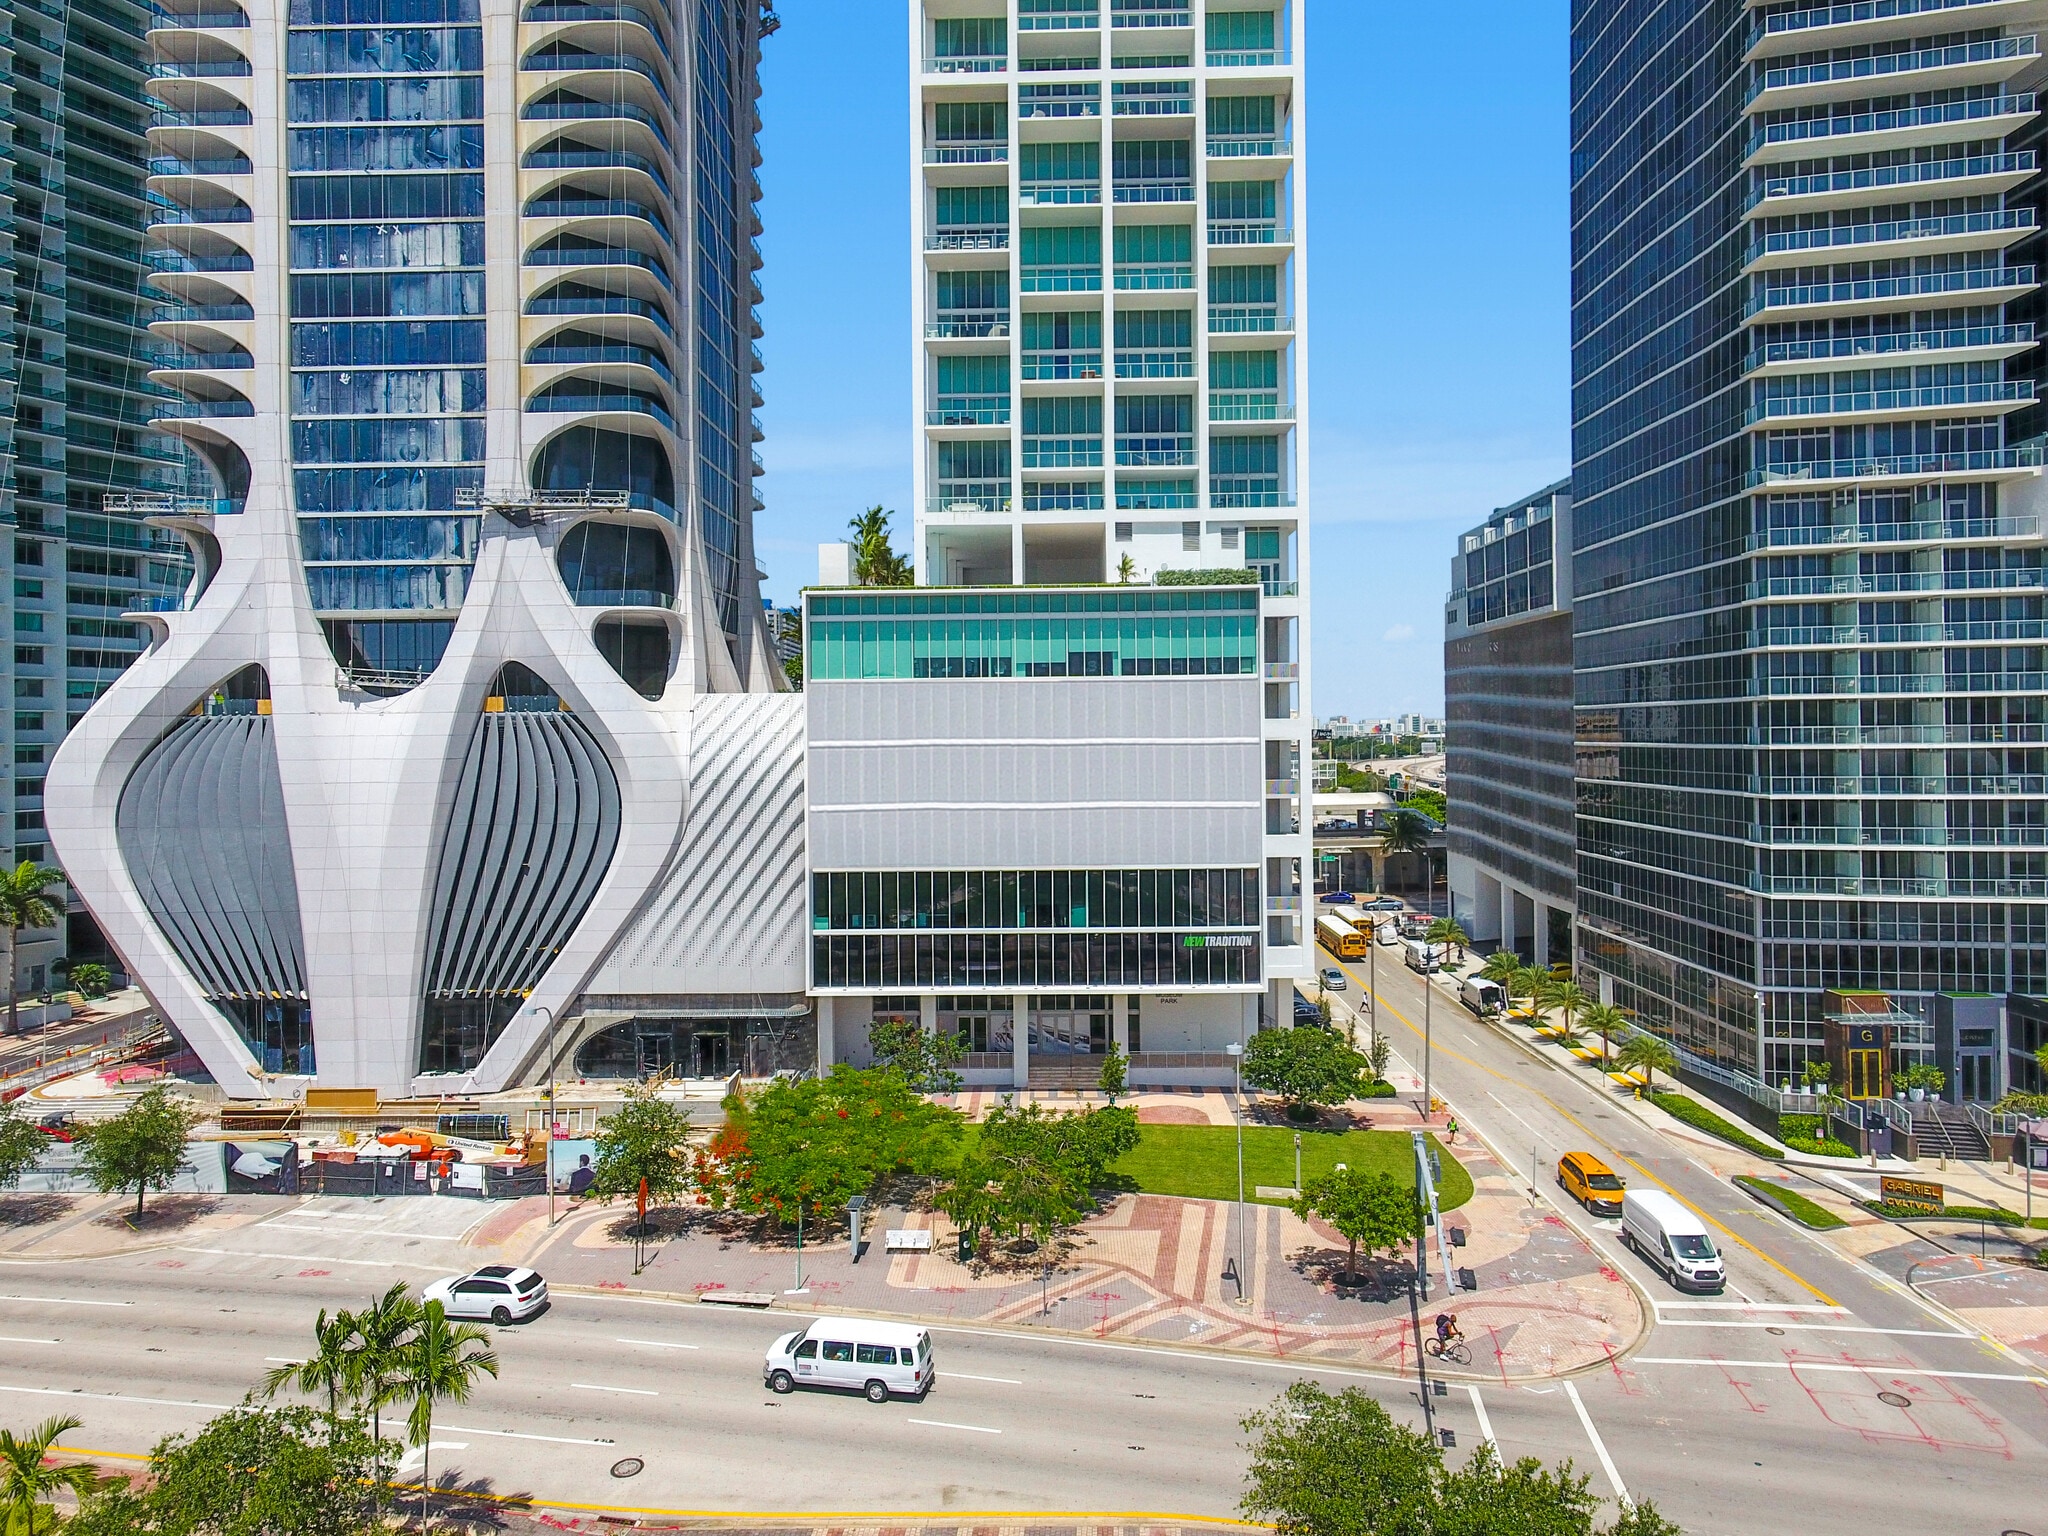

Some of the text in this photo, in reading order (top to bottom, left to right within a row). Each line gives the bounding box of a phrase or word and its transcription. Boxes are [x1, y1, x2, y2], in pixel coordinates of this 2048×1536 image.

[1183, 935, 1252, 947] NEWTRADITION
[1861, 1030, 1873, 1042] G
[454, 1140, 492, 1151] United Rentals
[1886, 1180, 1940, 1197] GABRIEL
[1886, 1197, 1940, 1213] CVLTVRA
